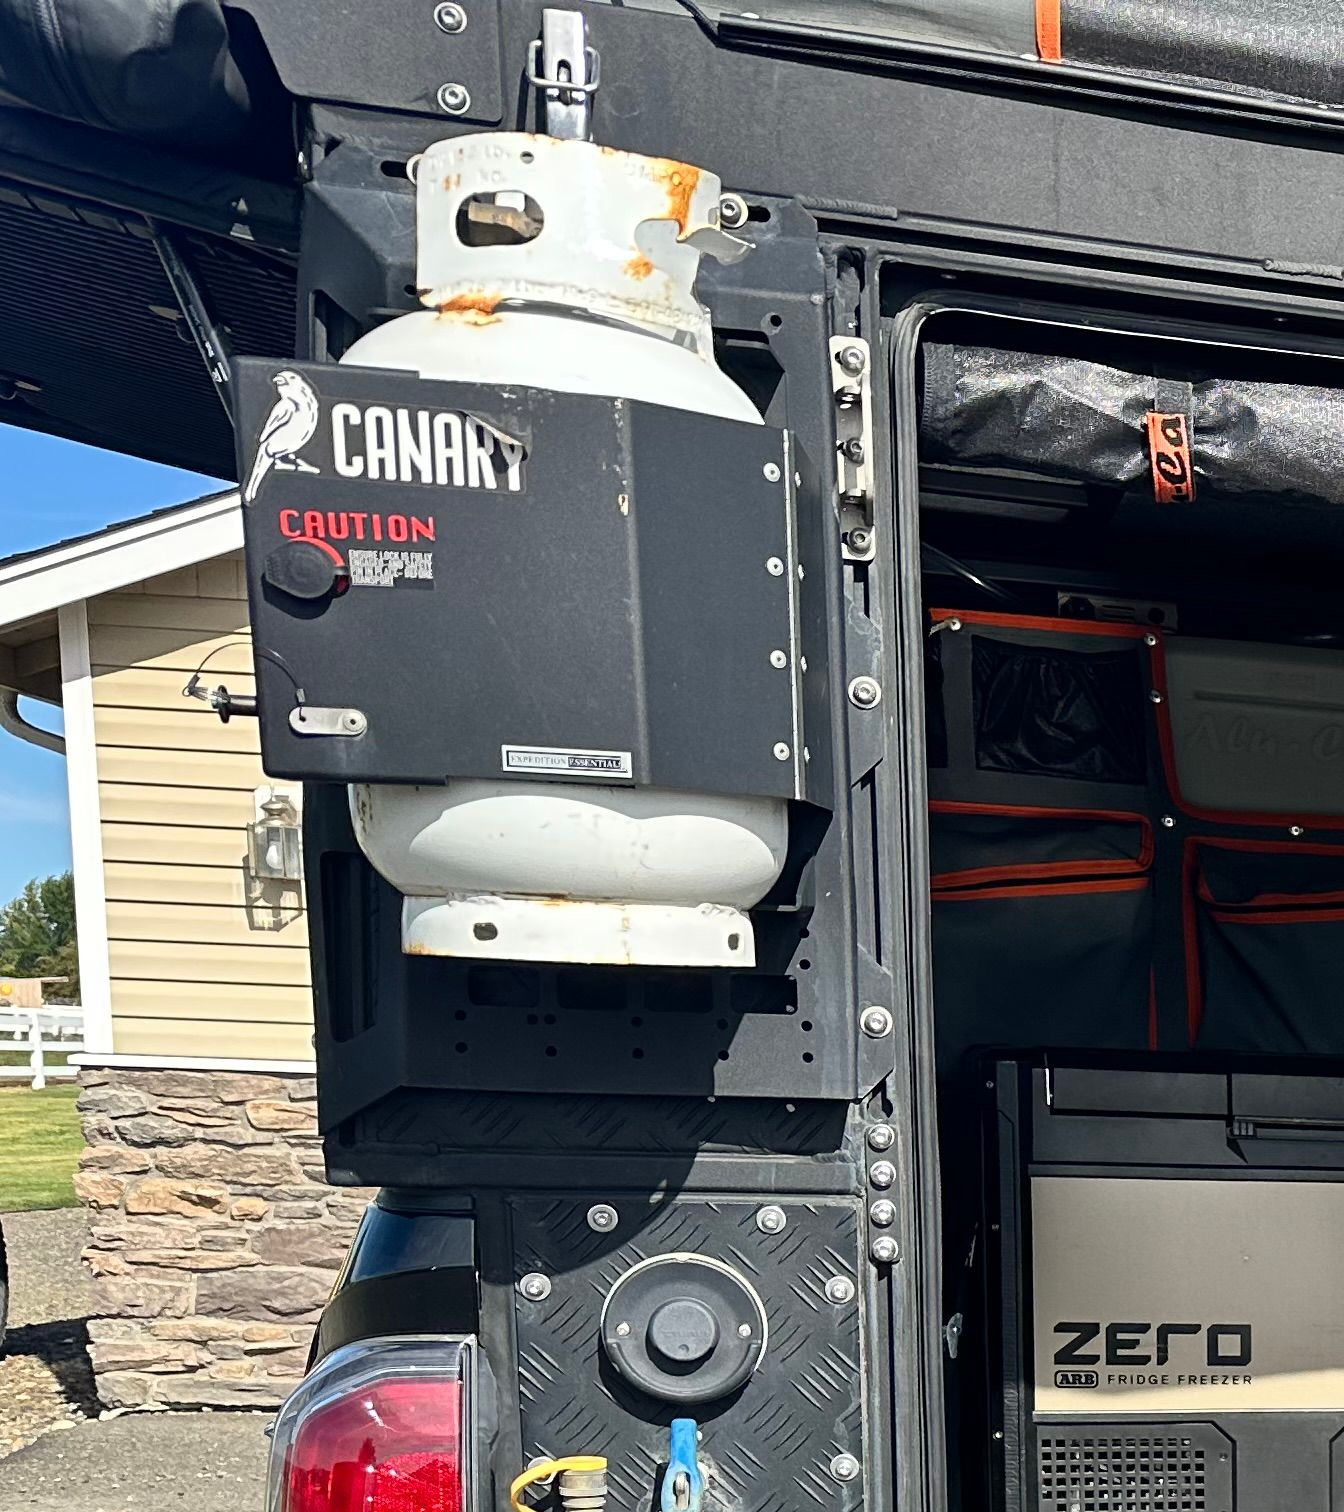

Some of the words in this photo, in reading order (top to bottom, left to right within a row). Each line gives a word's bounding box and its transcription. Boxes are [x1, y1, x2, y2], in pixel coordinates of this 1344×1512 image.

[331, 403, 528, 492] CANARY
[279, 508, 436, 543] CAUTION
[1057, 1373, 1096, 1386] ARB
[1107, 1374, 1170, 1385] FRIDGE
[1177, 1374, 1252, 1385] FREEZER
